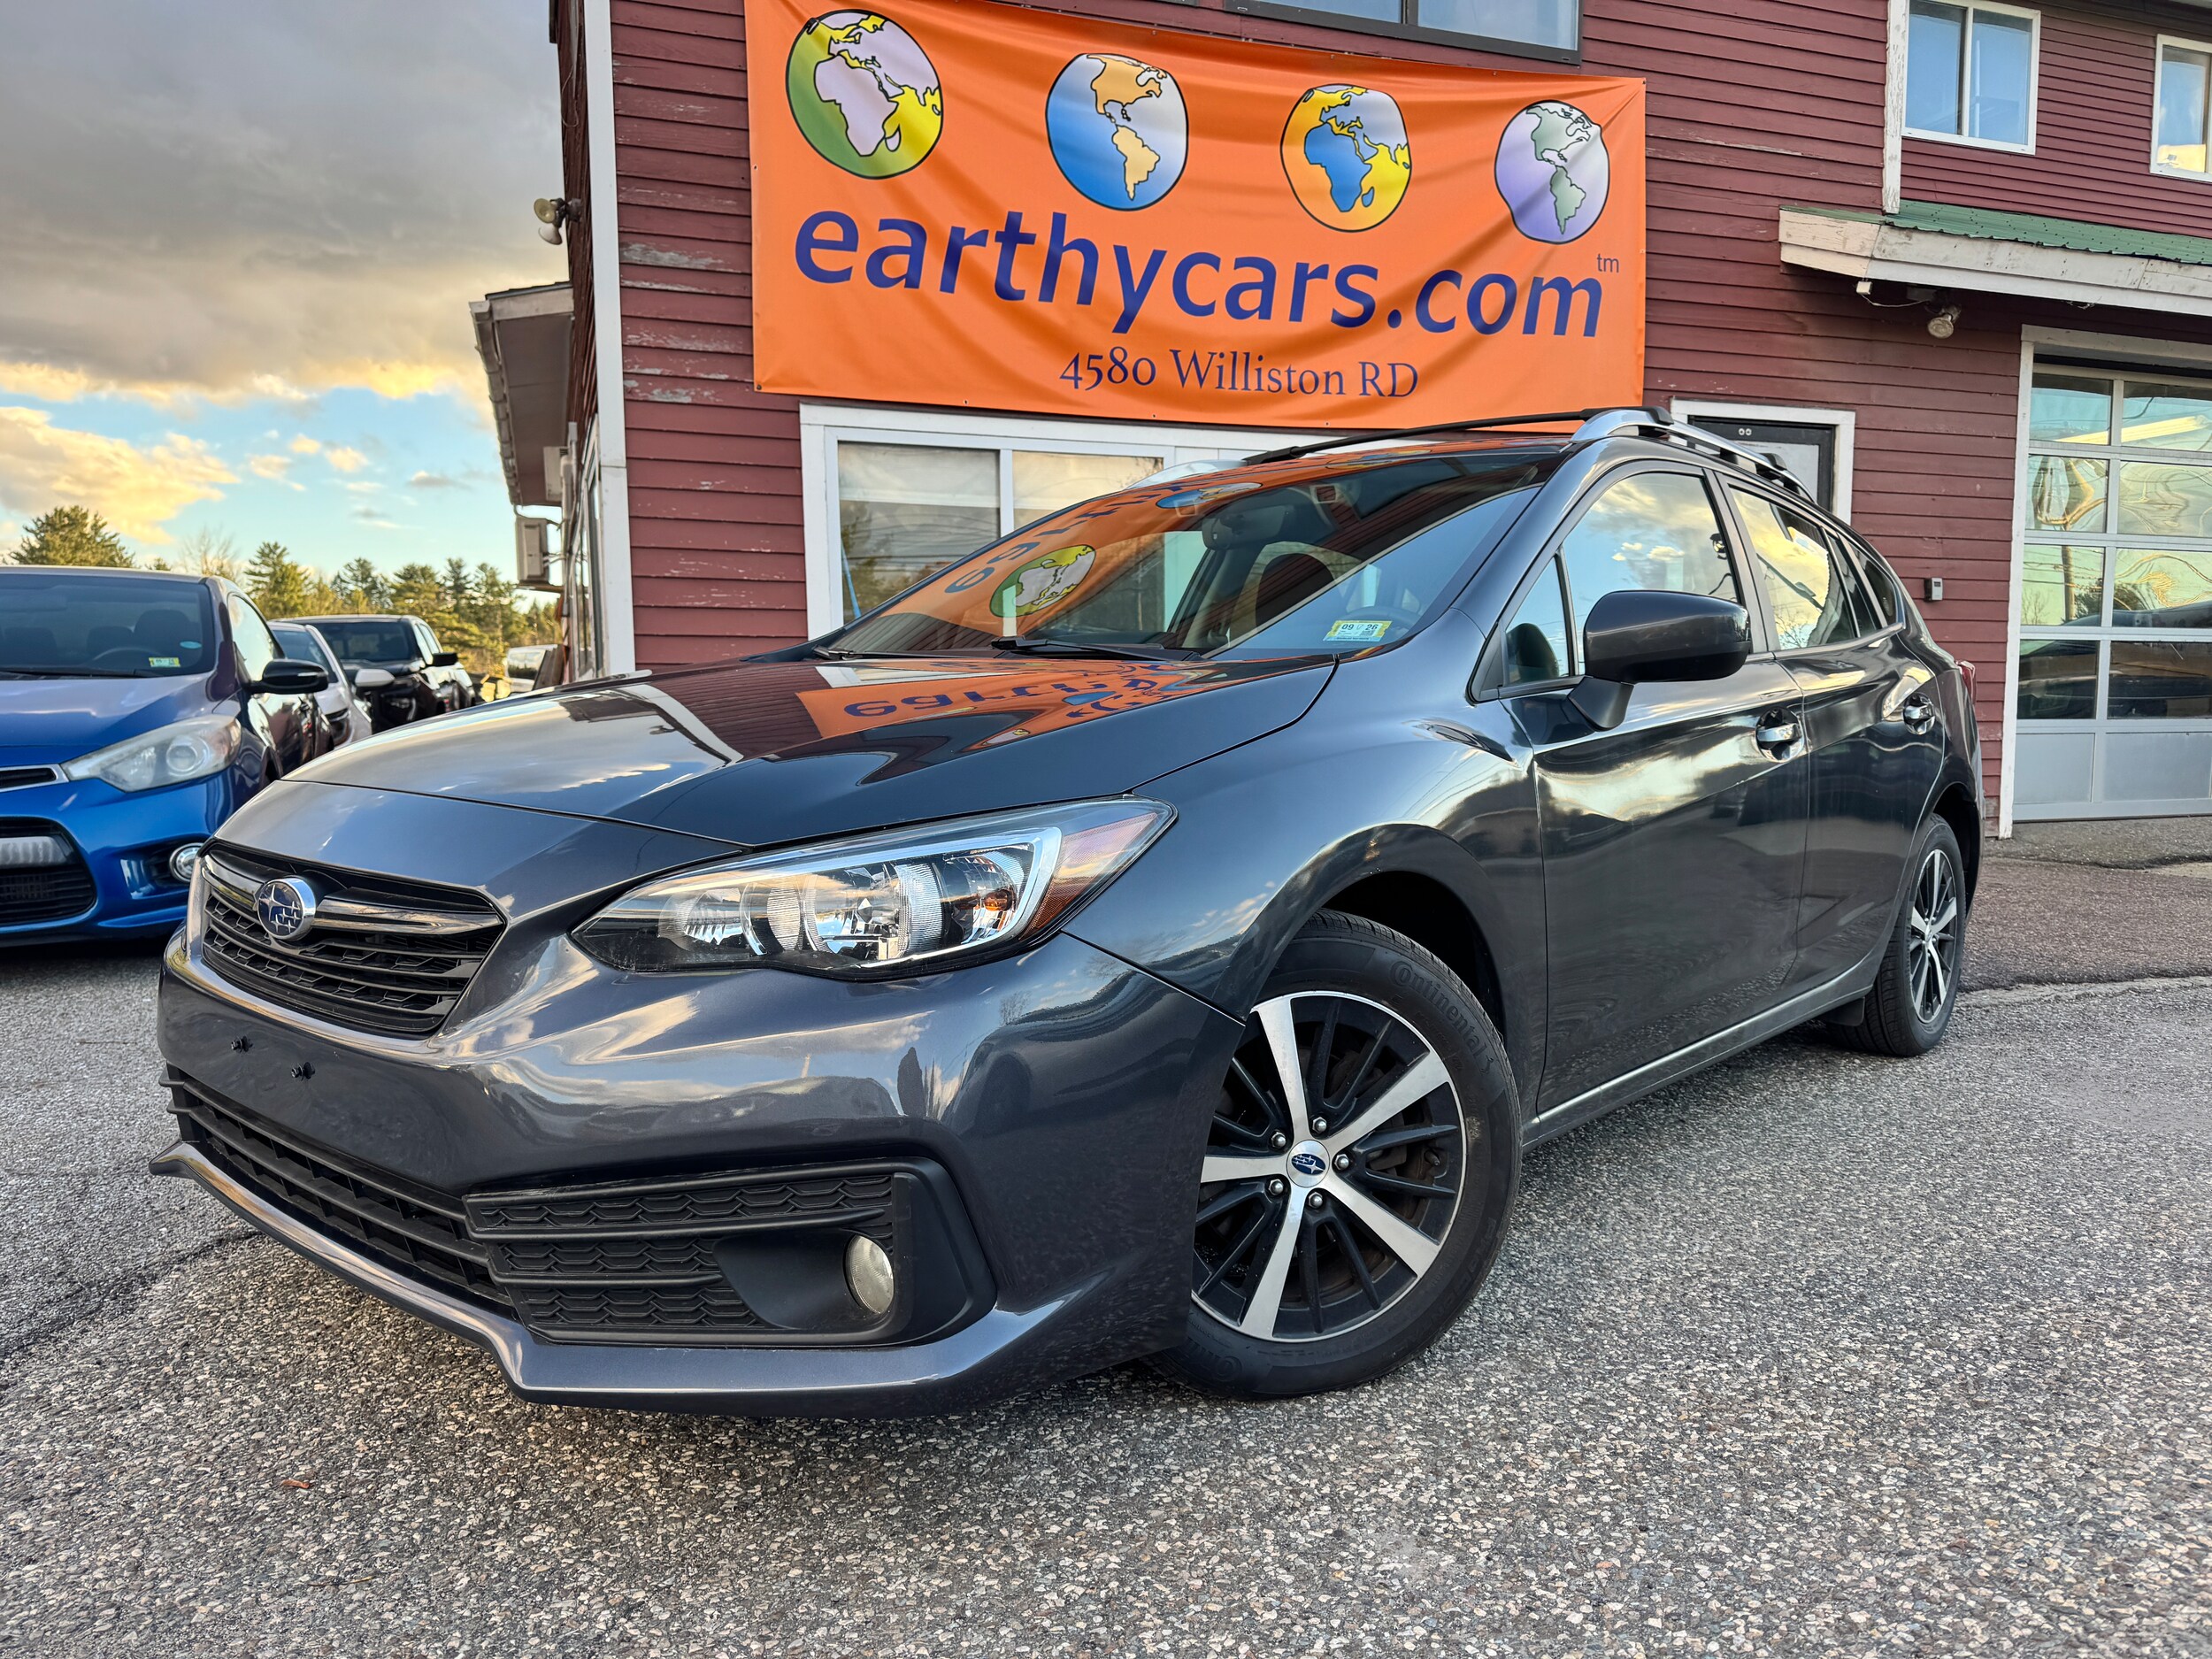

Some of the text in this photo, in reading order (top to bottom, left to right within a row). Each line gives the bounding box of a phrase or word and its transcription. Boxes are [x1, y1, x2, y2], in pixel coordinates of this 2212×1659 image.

[795, 210, 1603, 338] earthycars.com
[1596, 254, 1620, 273] tm
[1060, 347, 1419, 399] 4580 Williston RD
[1390, 960, 1487, 1057] Continental
